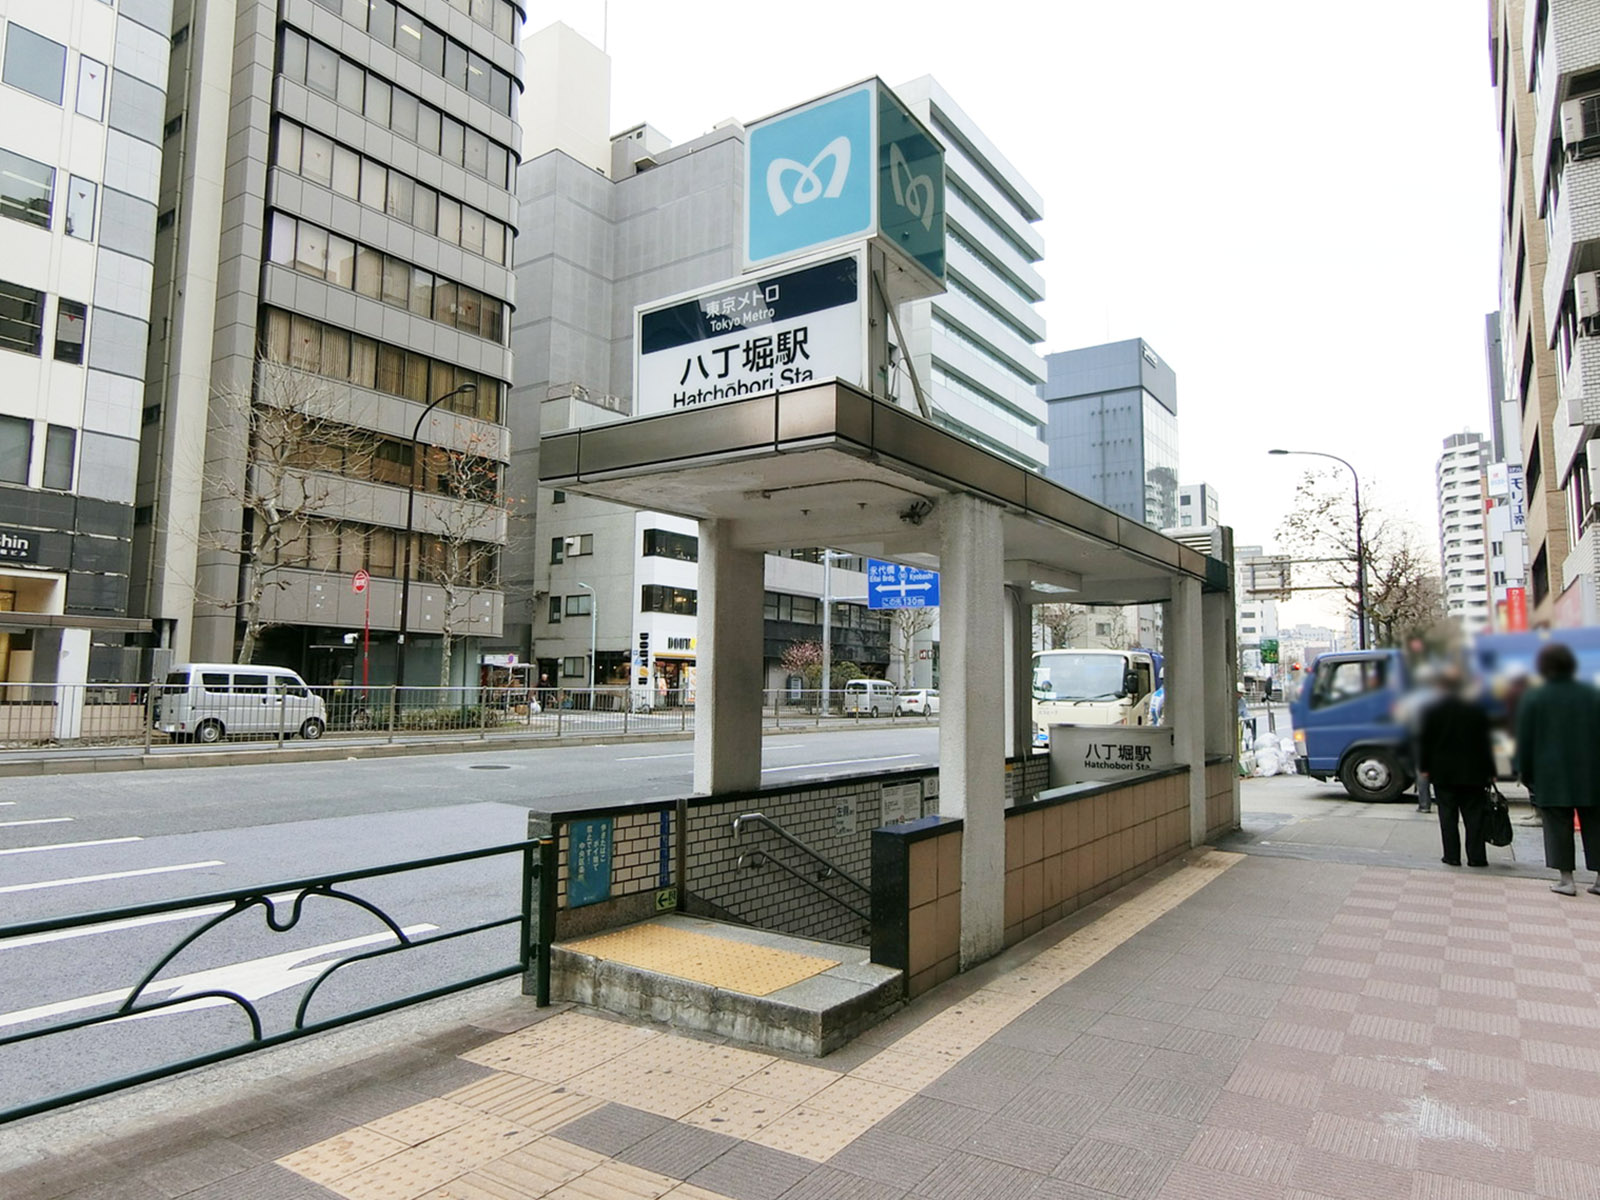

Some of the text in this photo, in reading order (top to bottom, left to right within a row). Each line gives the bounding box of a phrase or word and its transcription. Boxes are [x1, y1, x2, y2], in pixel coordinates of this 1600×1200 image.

[705, 284, 779, 319] 東京メトロ
[710, 308, 775, 332] Tokyo Metro
[680, 326, 811, 386] 八丁堀駅
[1085, 744, 1152, 761] 八丁堀駅
